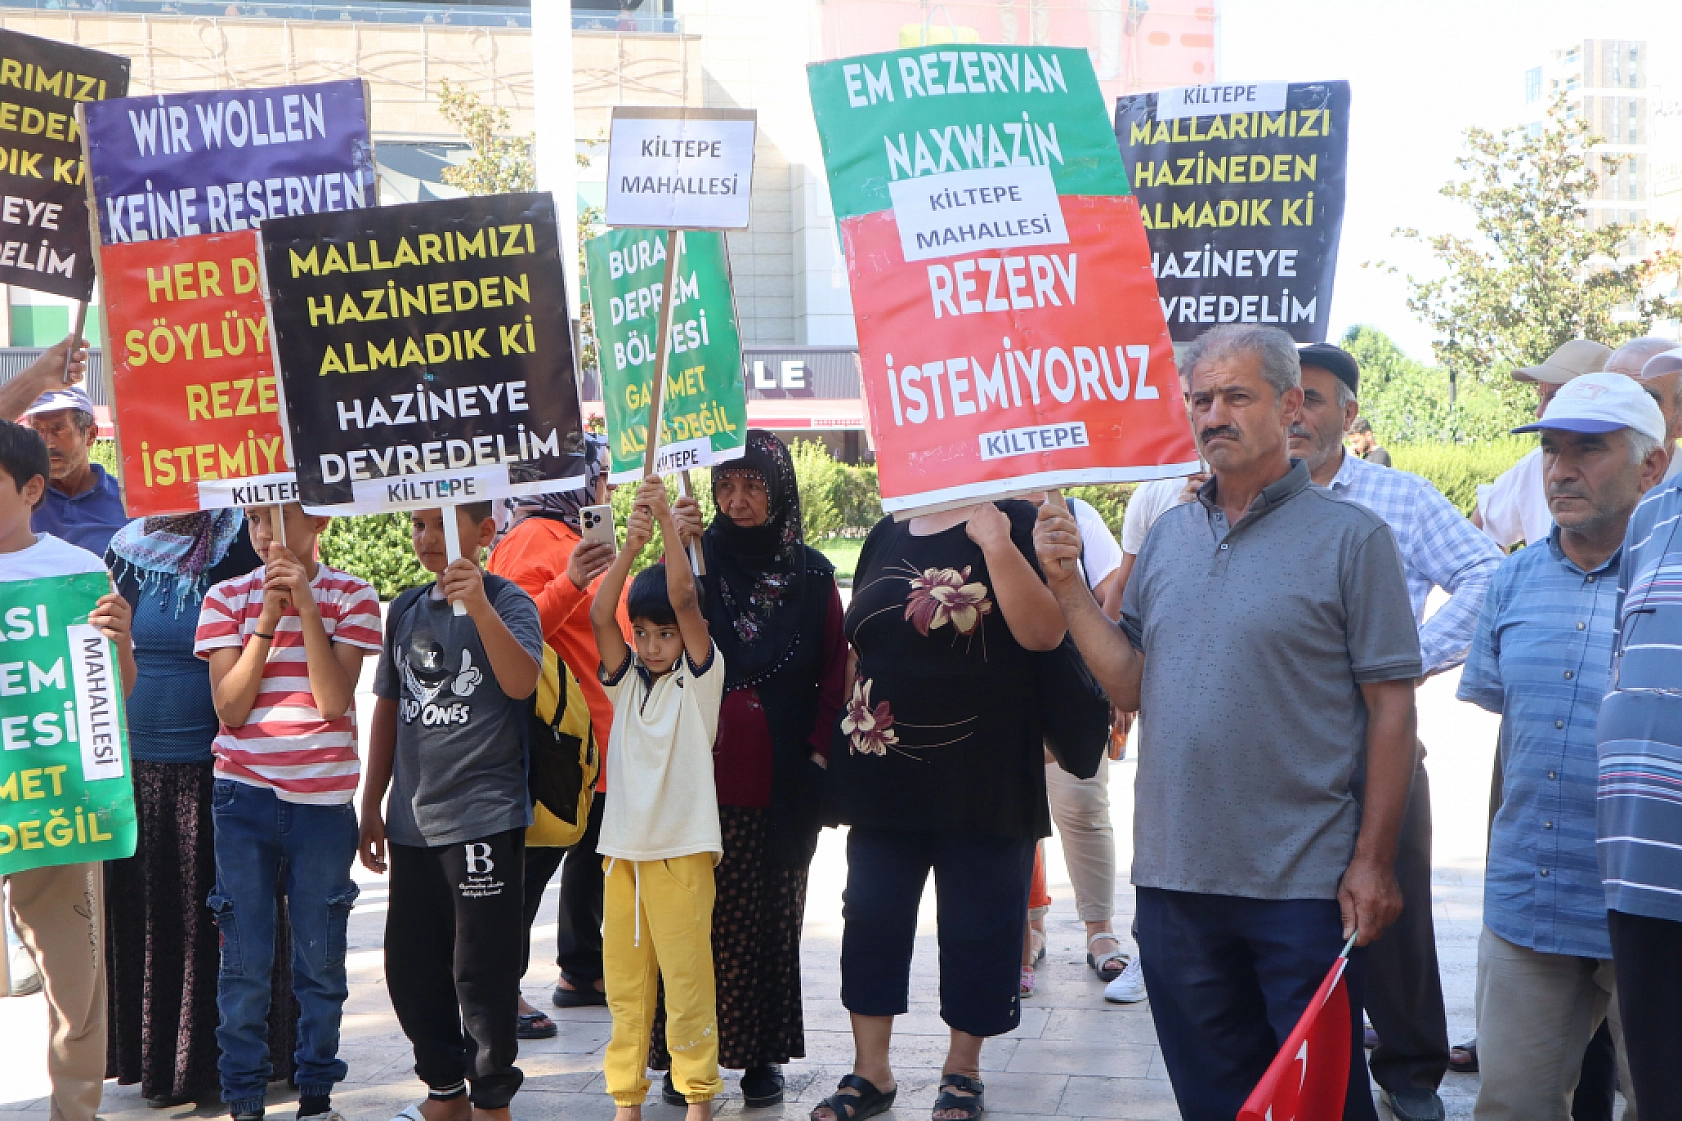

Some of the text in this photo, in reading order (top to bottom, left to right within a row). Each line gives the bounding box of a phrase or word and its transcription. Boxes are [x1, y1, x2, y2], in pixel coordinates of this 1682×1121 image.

[843, 51, 1069, 109] EM REZERVAN
[1184, 84, 1258, 105] KİLTEPE
[128, 92, 326, 157] WİR WOLLEN
[641, 135, 722, 159] KİLTEPE
[884, 110, 1065, 181] NAXWAZİN
[1129, 109, 1331, 147] MALLARIMIZI
[620, 172, 739, 196] MAHALLESİ
[1134, 150, 1317, 188] HAZİNEDEN
[106, 170, 367, 244] KEİNE RESERVEN
[929, 185, 1023, 212] KİLTEPE
[1140, 190, 1315, 230] ALMADIK Kİ
[288, 223, 536, 279] MALLARIMIZI
[916, 213, 1052, 250] MAHALLESİ
[0, 239, 76, 279] ELİM
[146, 254, 261, 303] HER D
[306, 273, 531, 328] HAZİNEDEN
[927, 252, 1078, 320] REZERV
[318, 314, 537, 377] ALMADIK Kİ
[613, 308, 710, 371] BÖLESİ
[185, 375, 280, 421] REZE
[744, 360, 806, 390] LE
[885, 336, 1160, 426] İSTEMİYORUZ
[336, 380, 530, 431] HAZİNEYE
[141, 429, 288, 488] İSTEMİY
[318, 422, 560, 485] DEVREDELİM
[986, 425, 1086, 457] KİLTEPE
[387, 476, 476, 503] KİLTEPE
[0, 604, 49, 643] SI
[82, 637, 119, 766] MAHALLESİ
[422, 702, 470, 727] ONES
[2, 700, 78, 752] ESİ
[464, 842, 495, 874] B
